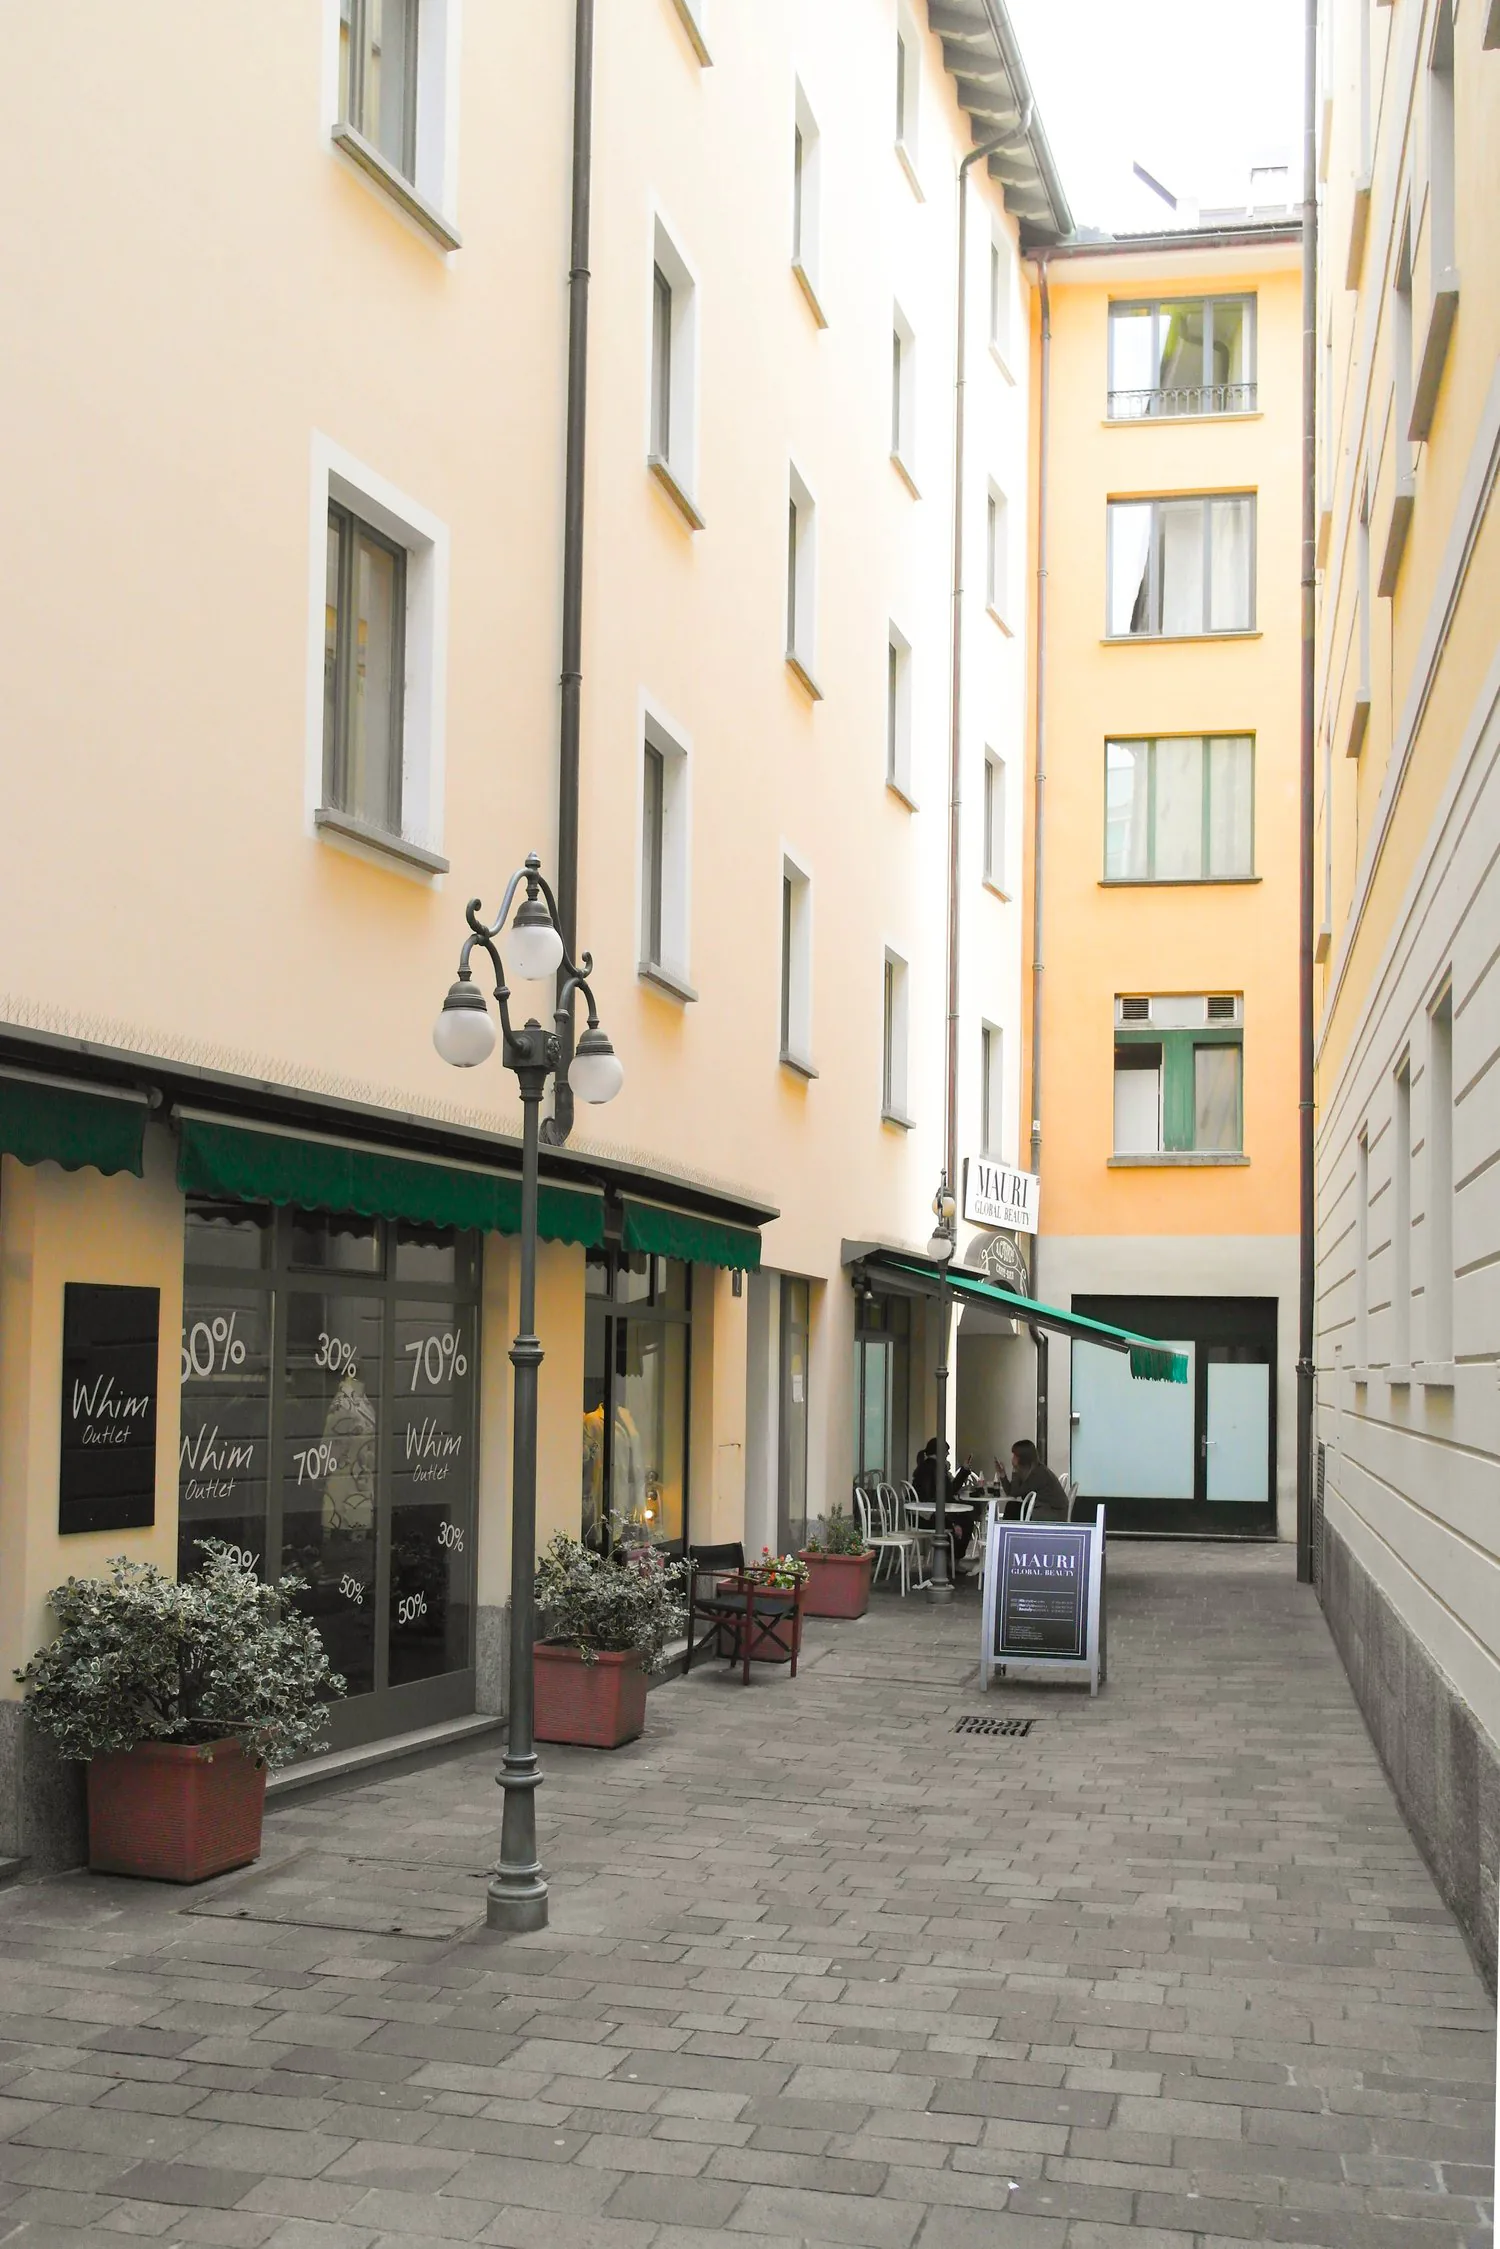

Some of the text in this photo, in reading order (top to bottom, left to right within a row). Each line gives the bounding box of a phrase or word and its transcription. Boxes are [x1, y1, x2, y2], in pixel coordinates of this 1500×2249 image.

[976, 1165, 1028, 1208] MAURI
[975, 1200, 1029, 1225] GLOBAL BEAUTY
[314, 1332, 357, 1378] 30%
[405, 1329, 468, 1392] 70%
[73, 1374, 149, 1420] Whim
[82, 1424, 132, 1445] Outlet
[405, 1416, 462, 1460] Whim
[293, 1440, 338, 1486] 70%
[412, 1463, 449, 1483] Outlet
[185, 1476, 236, 1501] Outlet
[437, 1521, 465, 1552] 30%
[1010, 1568, 1074, 1577] GLOBAL BEAUTY
[1012, 1553, 1076, 1569] MAURI
[338, 1574, 366, 1605] 50%
[398, 1590, 428, 1625] 50%
